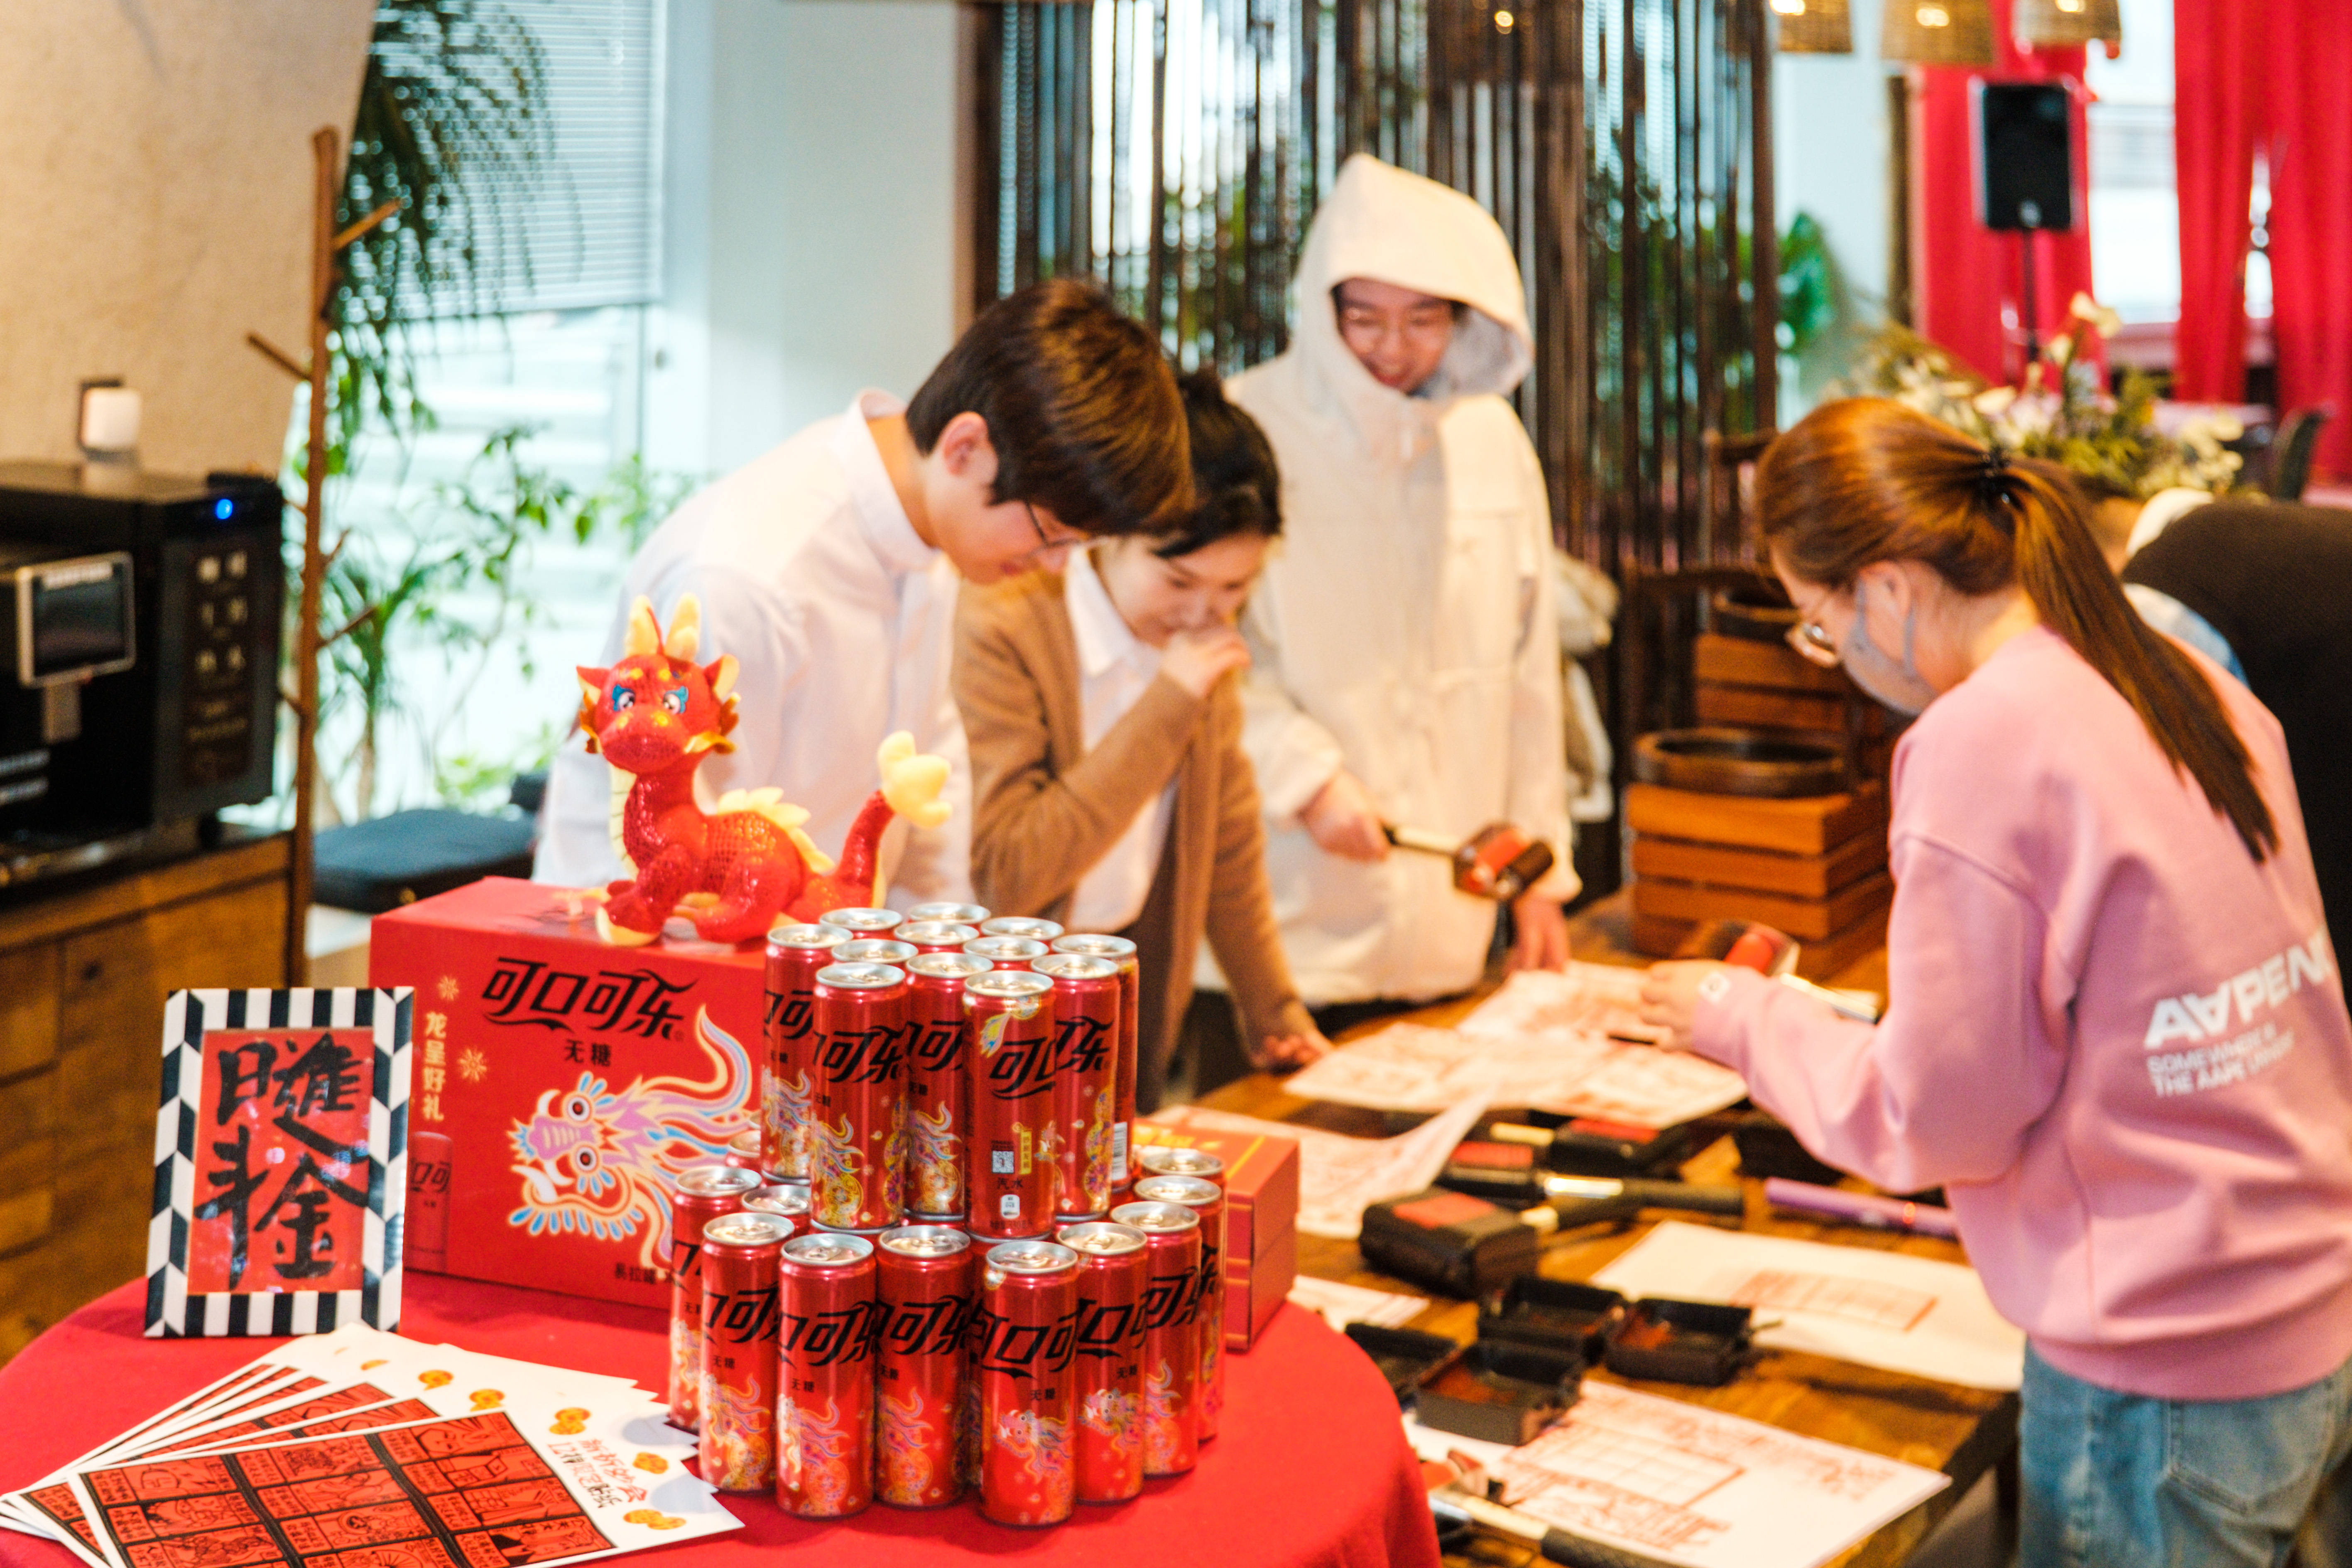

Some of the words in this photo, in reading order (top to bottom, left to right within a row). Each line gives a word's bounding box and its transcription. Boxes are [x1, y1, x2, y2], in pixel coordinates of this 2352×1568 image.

[482, 956, 698, 1041] 可口可乐
[423, 1012, 447, 1122] 龙呈好礼
[563, 1039, 611, 1067] 无糖
